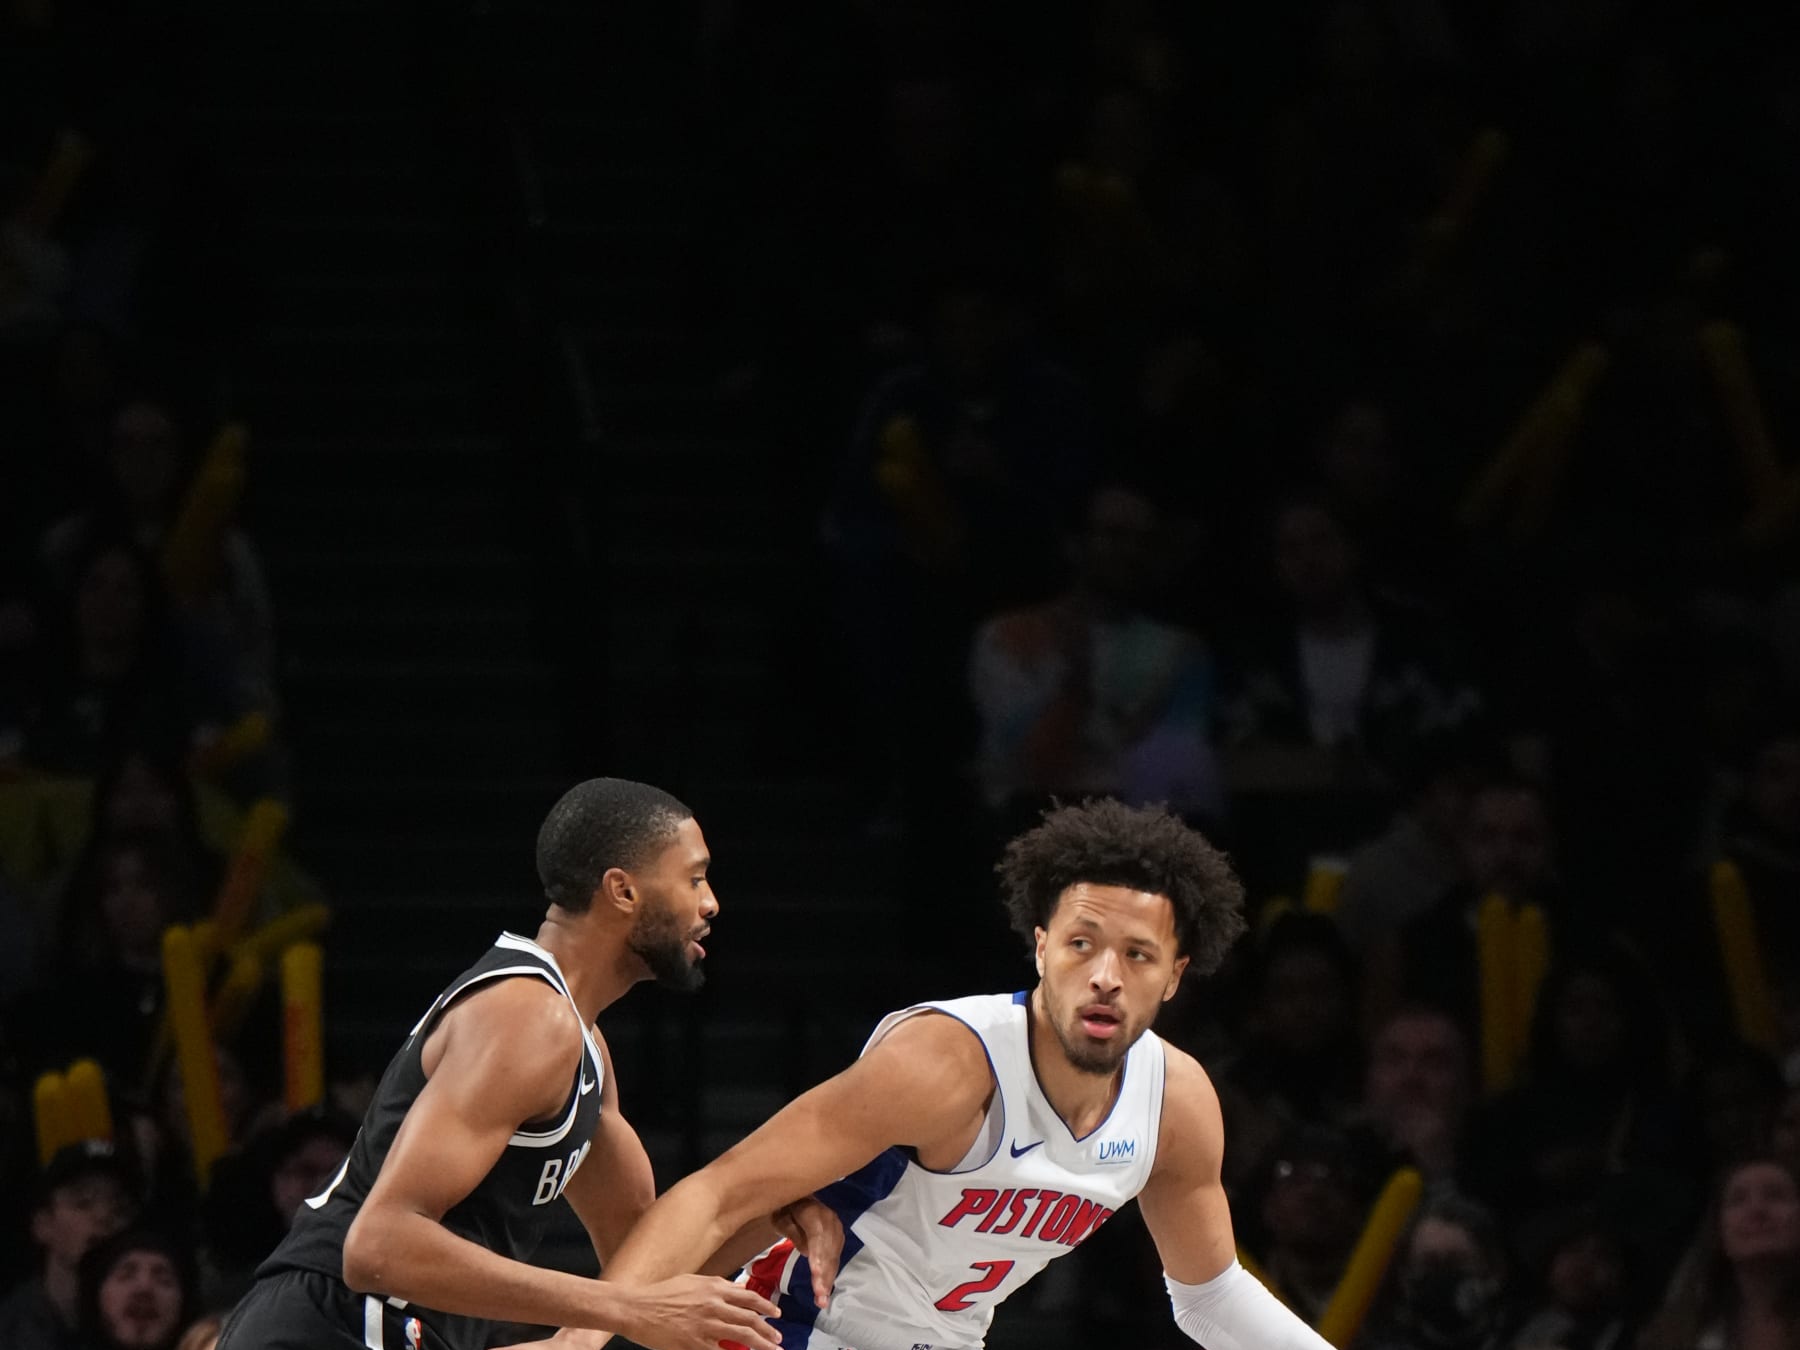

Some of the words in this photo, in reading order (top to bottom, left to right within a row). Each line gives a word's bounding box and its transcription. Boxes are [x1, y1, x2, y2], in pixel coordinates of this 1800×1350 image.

[532, 1139, 592, 1206] BR
[1099, 1139, 1134, 1159] UWM
[934, 1259, 1015, 1312] 2
